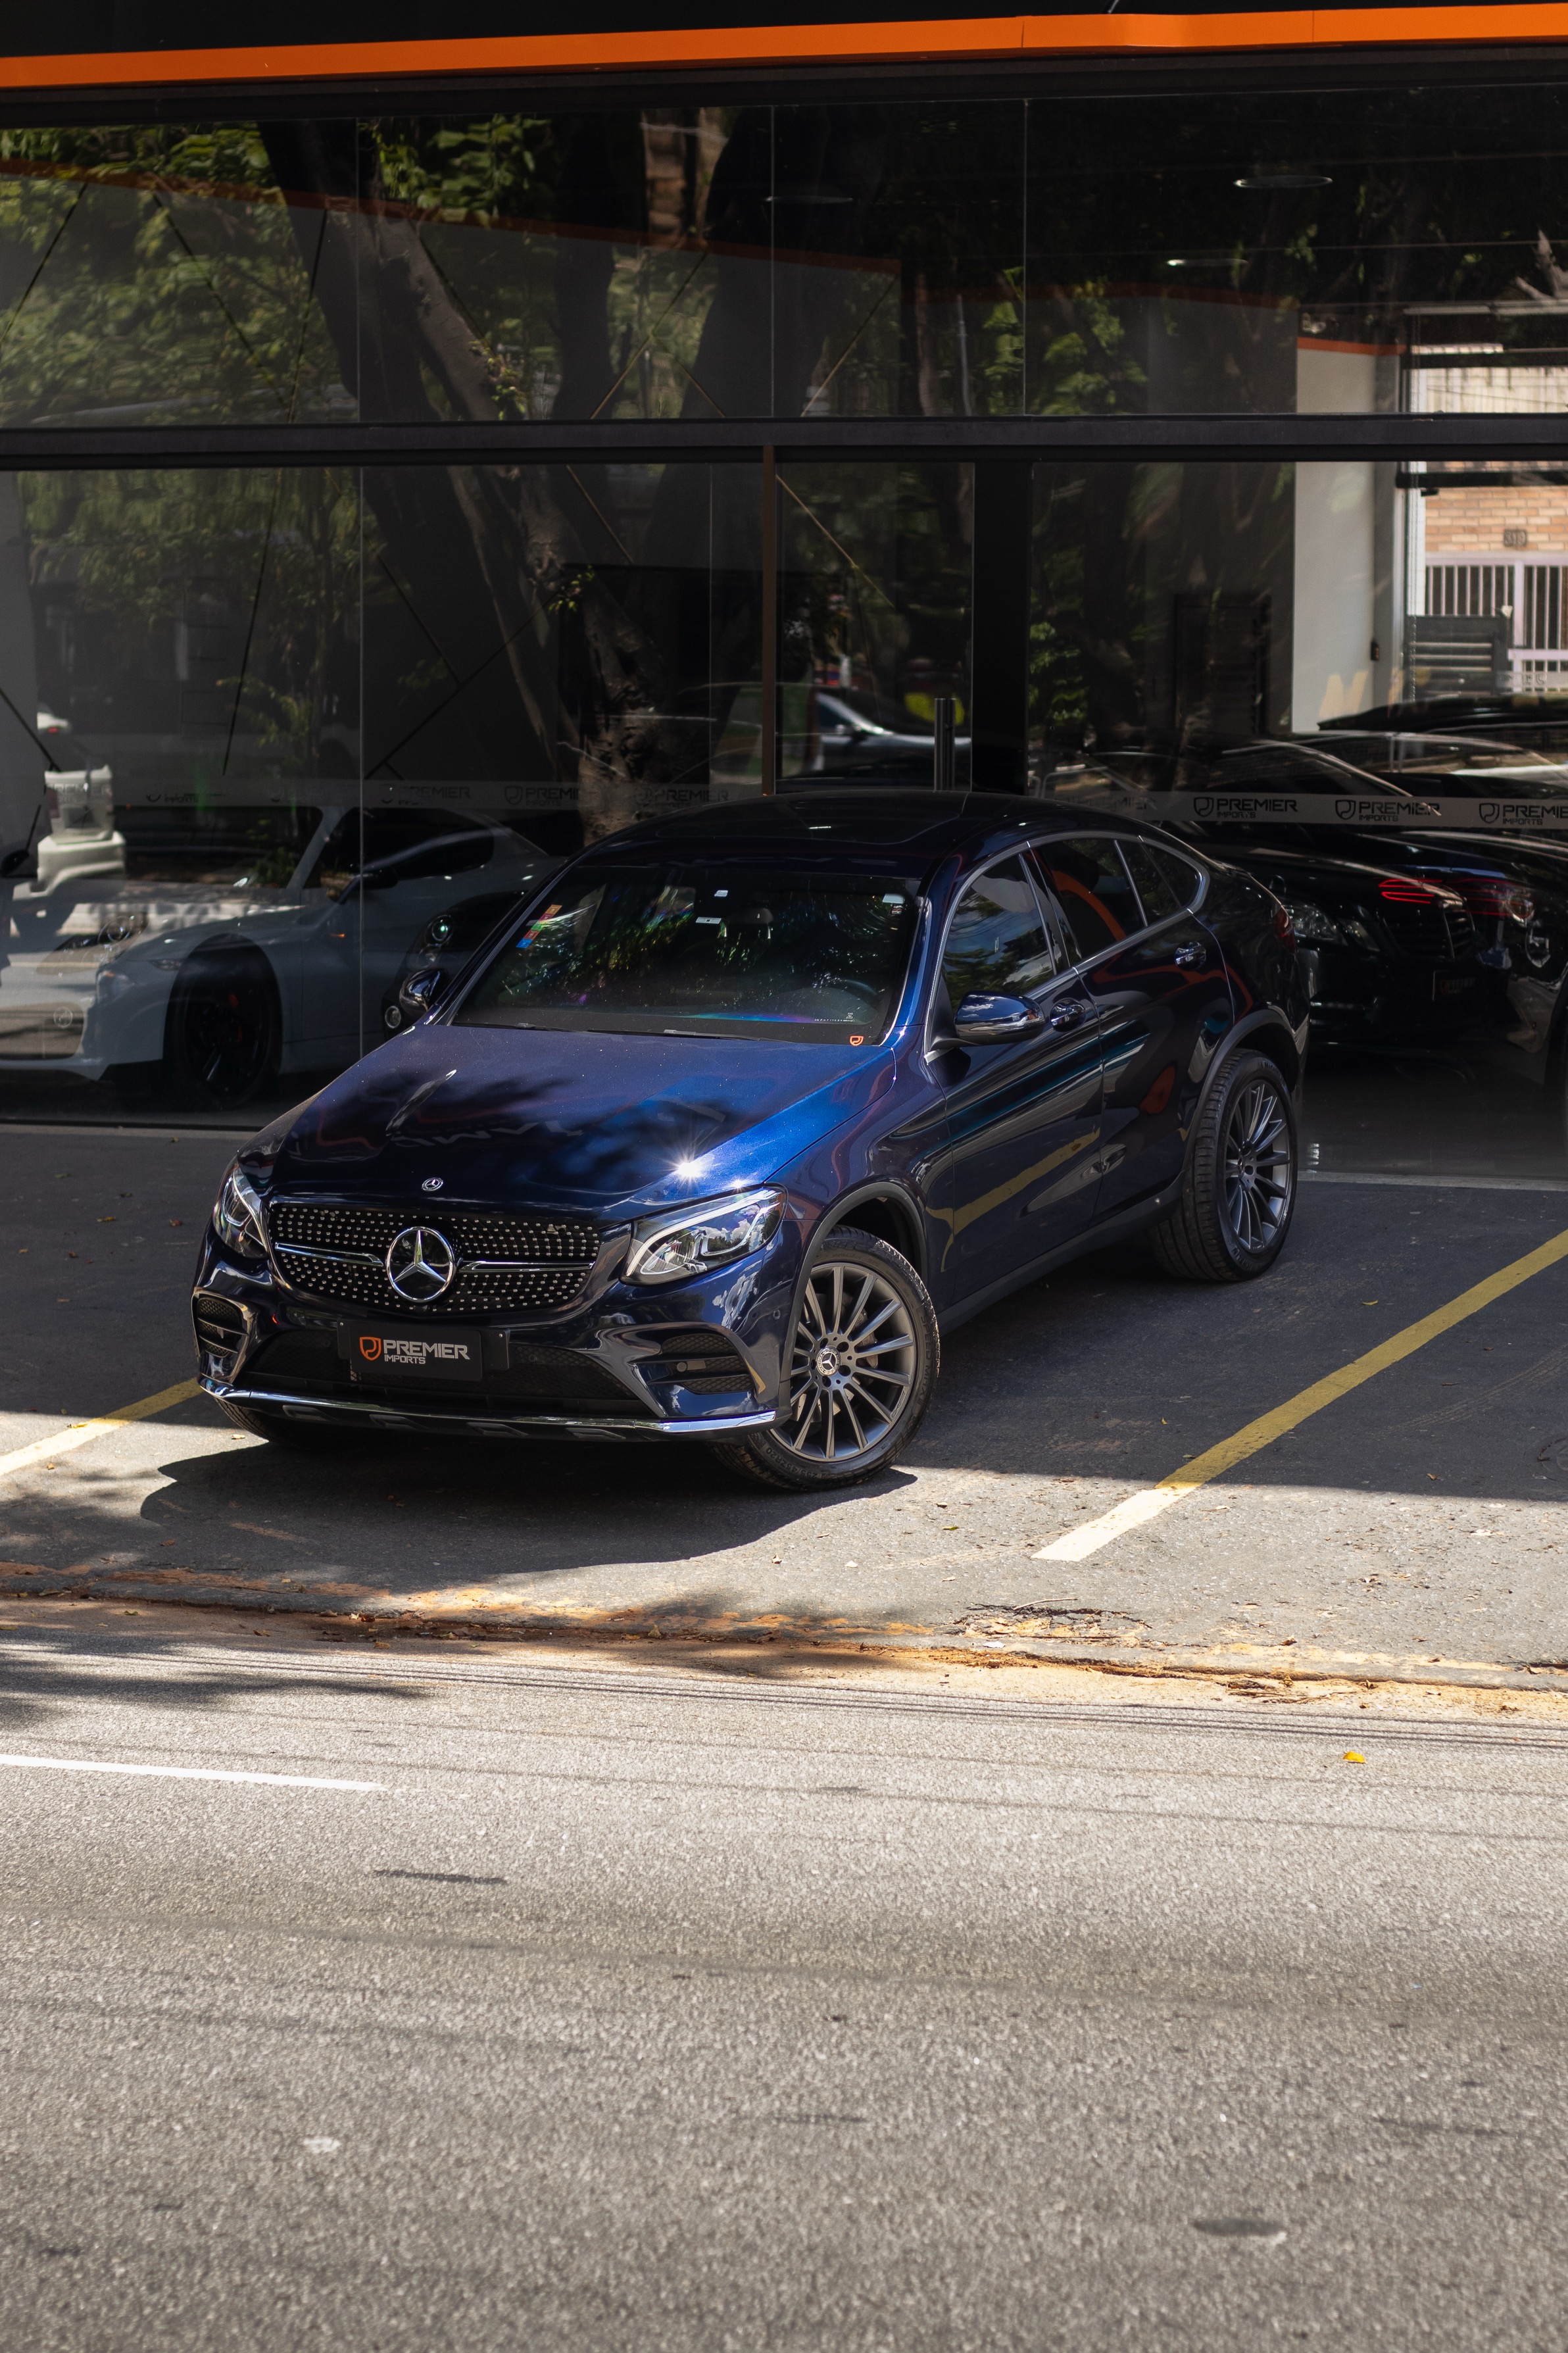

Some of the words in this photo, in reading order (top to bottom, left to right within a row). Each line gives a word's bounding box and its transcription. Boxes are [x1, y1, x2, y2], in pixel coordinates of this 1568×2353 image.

[526, 787, 600, 801] PREMI
[1217, 798, 1298, 812] PREMIER
[1359, 801, 1442, 816] PREMIER
[383, 1339, 470, 1360] PREMIER
[384, 1354, 426, 1364] IMPORTS
